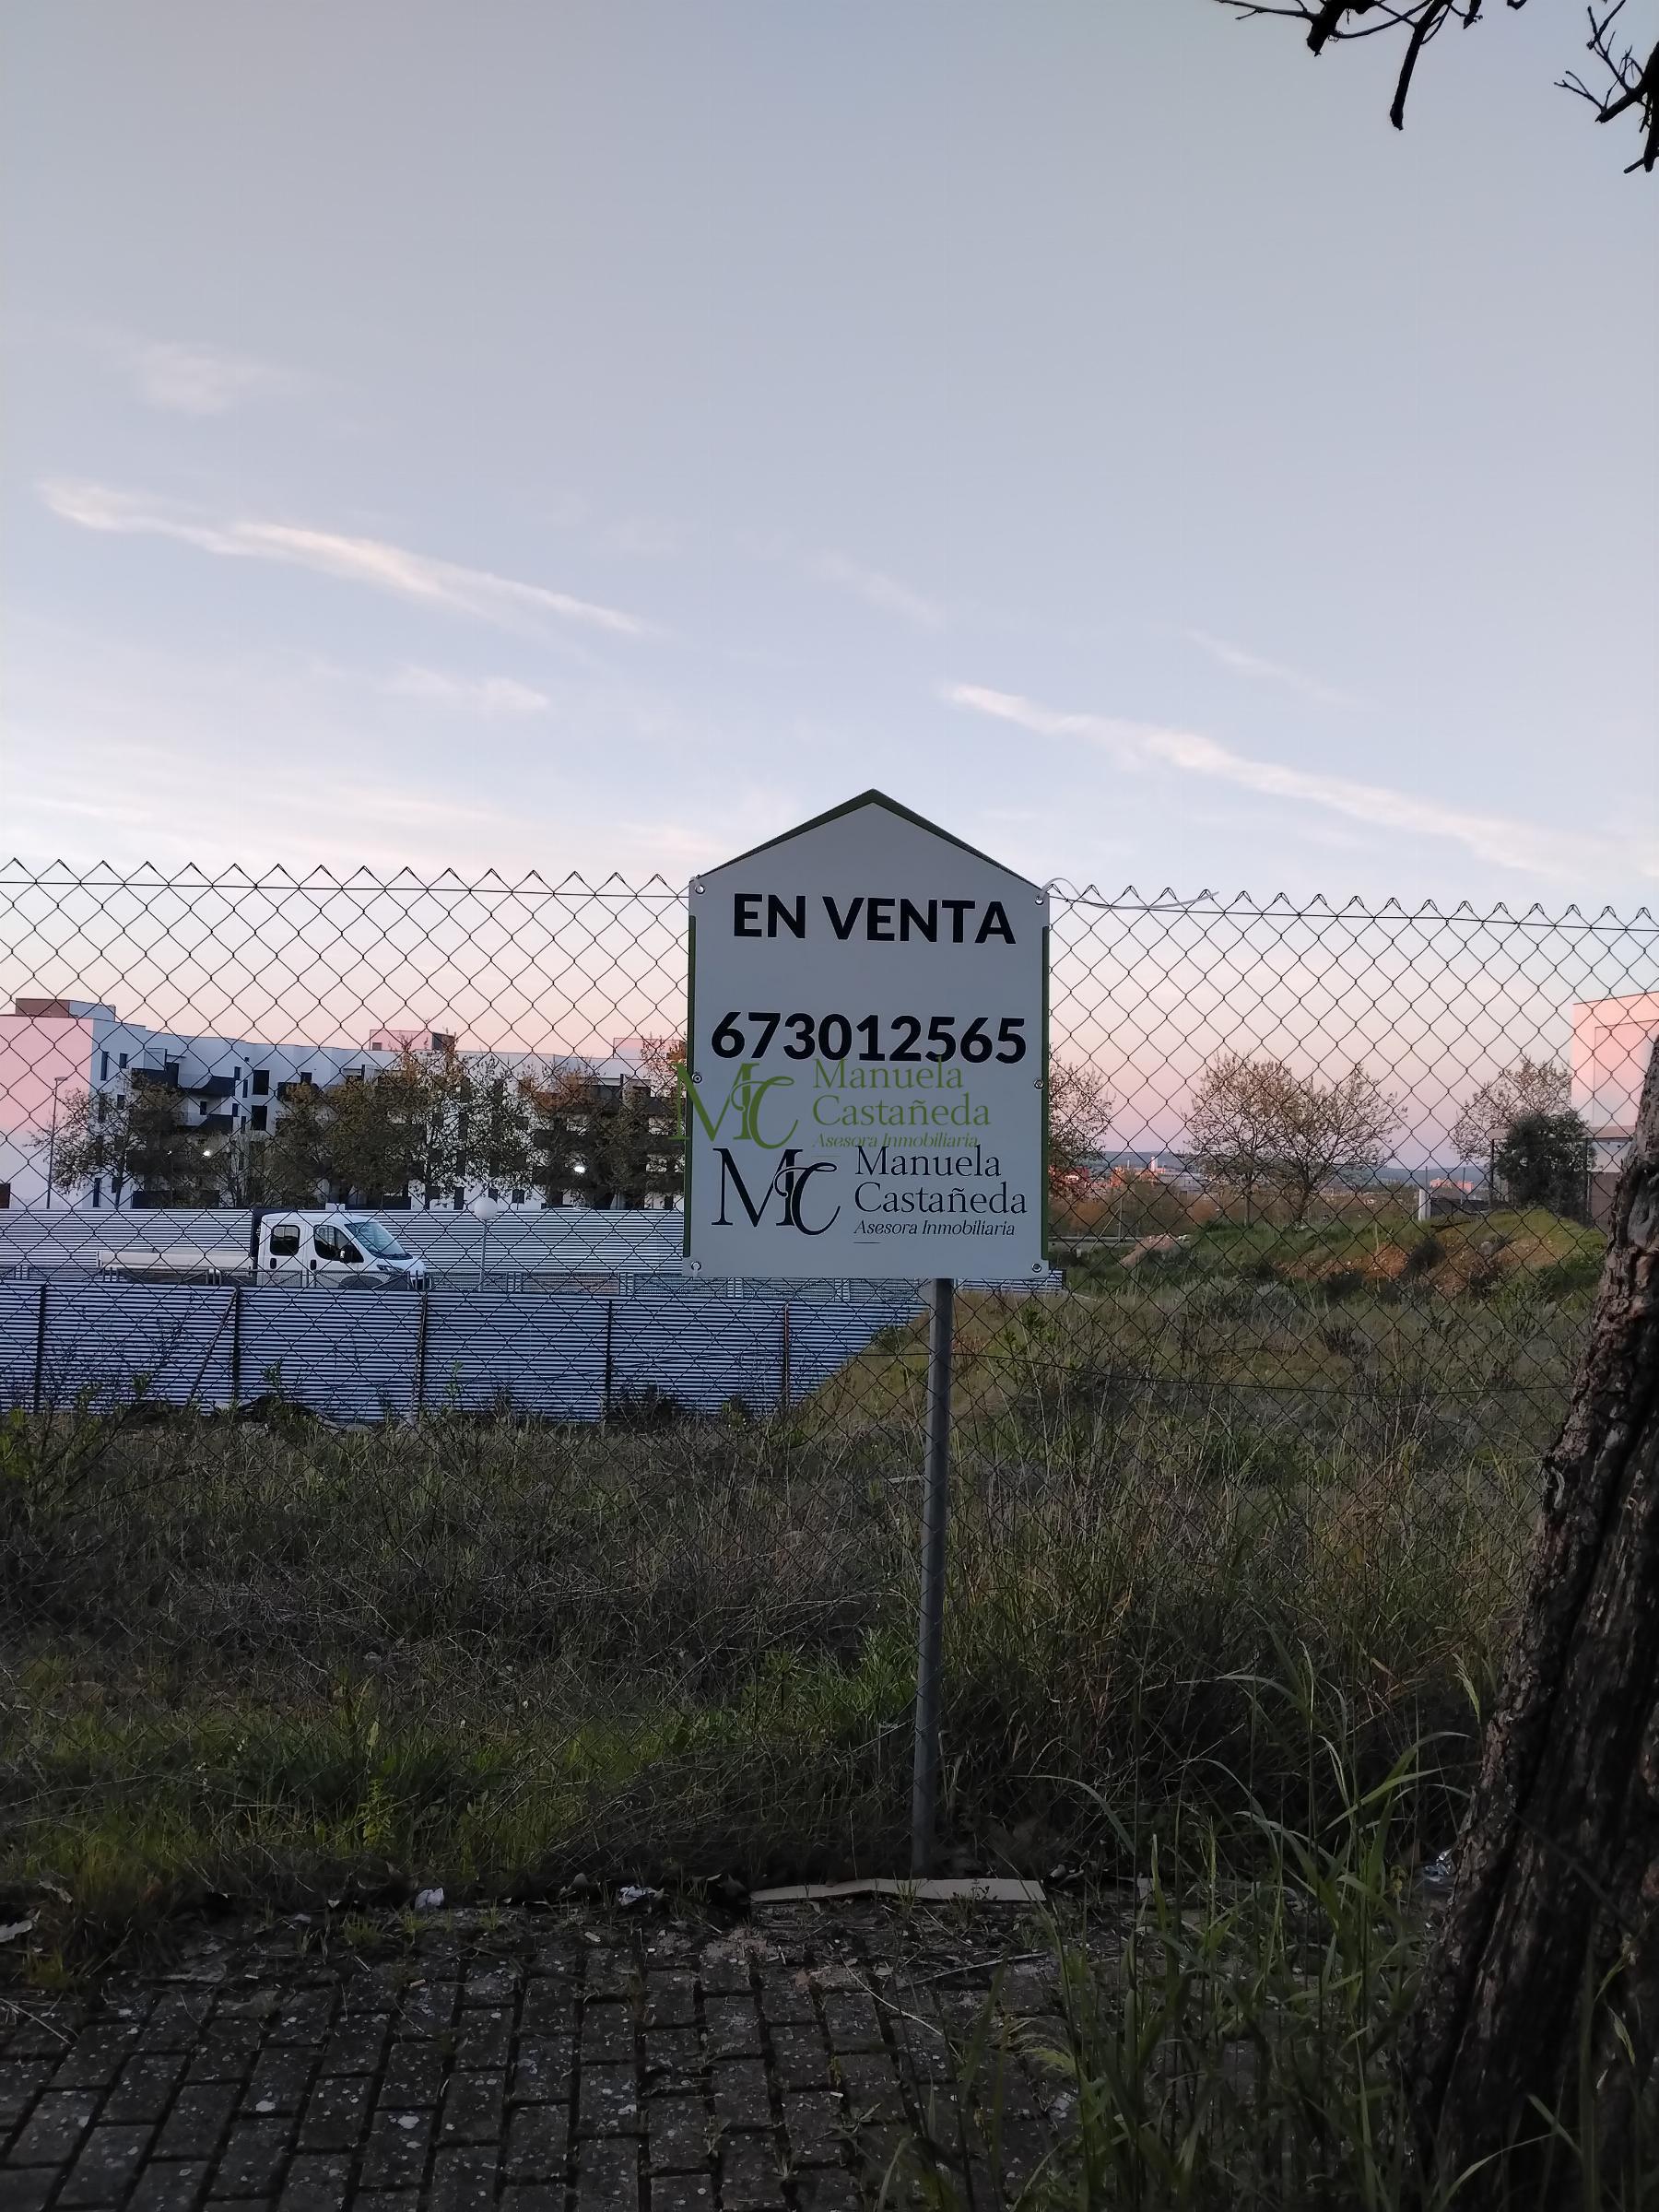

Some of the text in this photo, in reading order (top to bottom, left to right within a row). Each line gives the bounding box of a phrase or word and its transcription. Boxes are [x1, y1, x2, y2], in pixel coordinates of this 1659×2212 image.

[734, 893, 1016, 944] EN VENTA
[711, 1011, 1027, 1064] 673012565
[855, 1145, 1001, 1177] Manuela
[854, 1182, 1027, 1214] Castañeda
[853, 1219, 1016, 1236] Asesora Inmobiliaria
